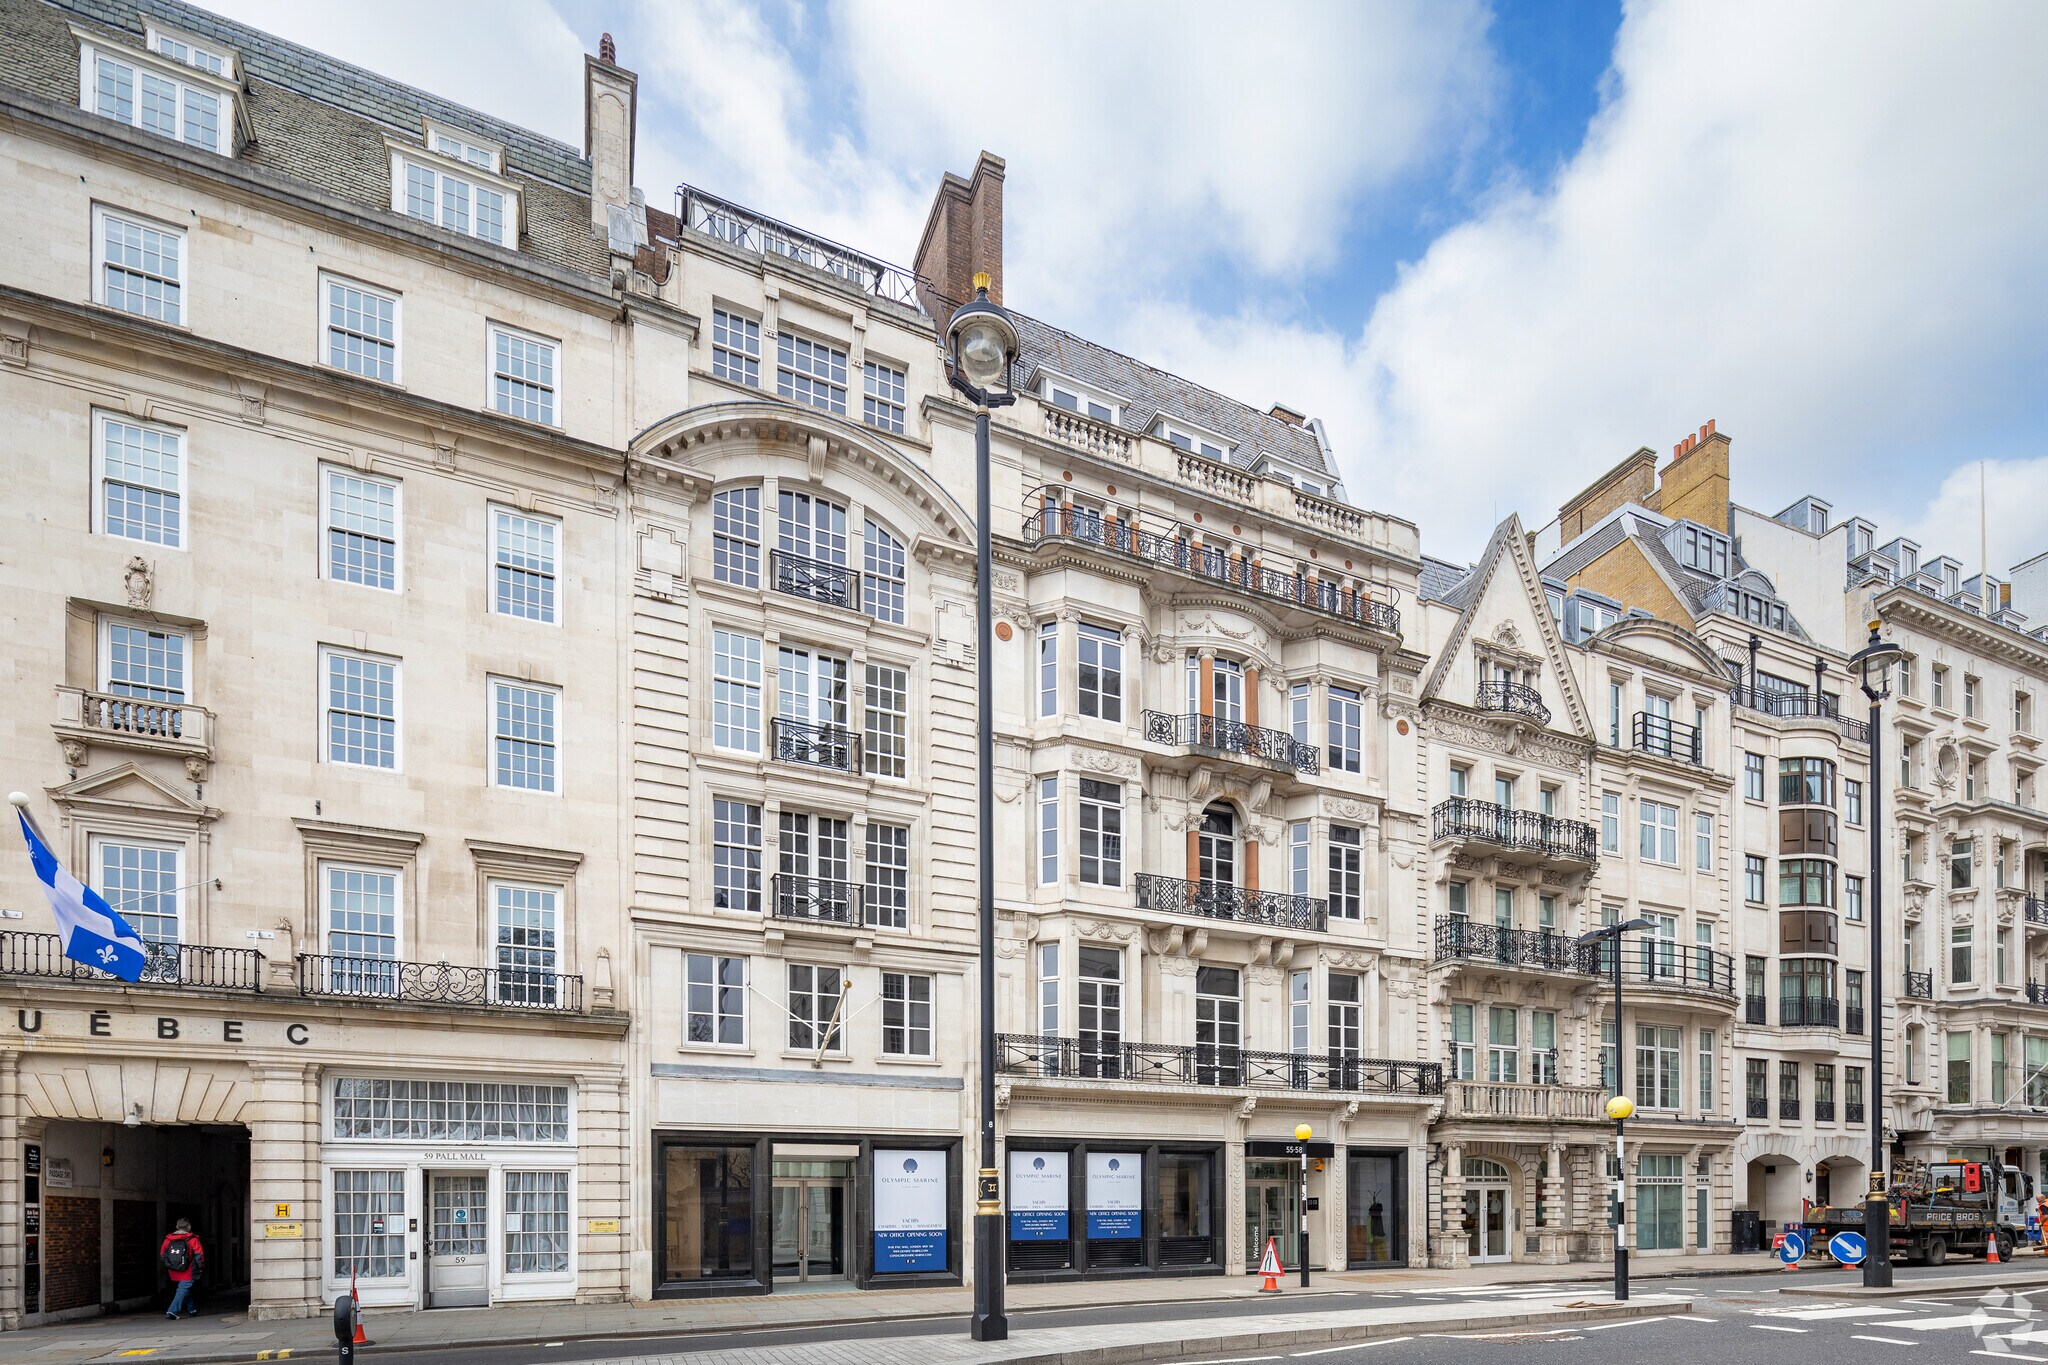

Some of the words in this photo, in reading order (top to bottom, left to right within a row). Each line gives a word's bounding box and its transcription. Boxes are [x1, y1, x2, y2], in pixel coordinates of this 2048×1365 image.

[435, 1153, 459, 1161] PALL
[459, 1153, 486, 1161] MALL
[49, 1169, 64, 1178] PASSAGE
[1248, 1166, 1275, 1174] 55-58
[277, 1205, 288, 1216] H
[1926, 1213, 1952, 1221] PRICE
[1956, 1213, 1980, 1221] BROS
[341, 1347, 349, 1355] S
